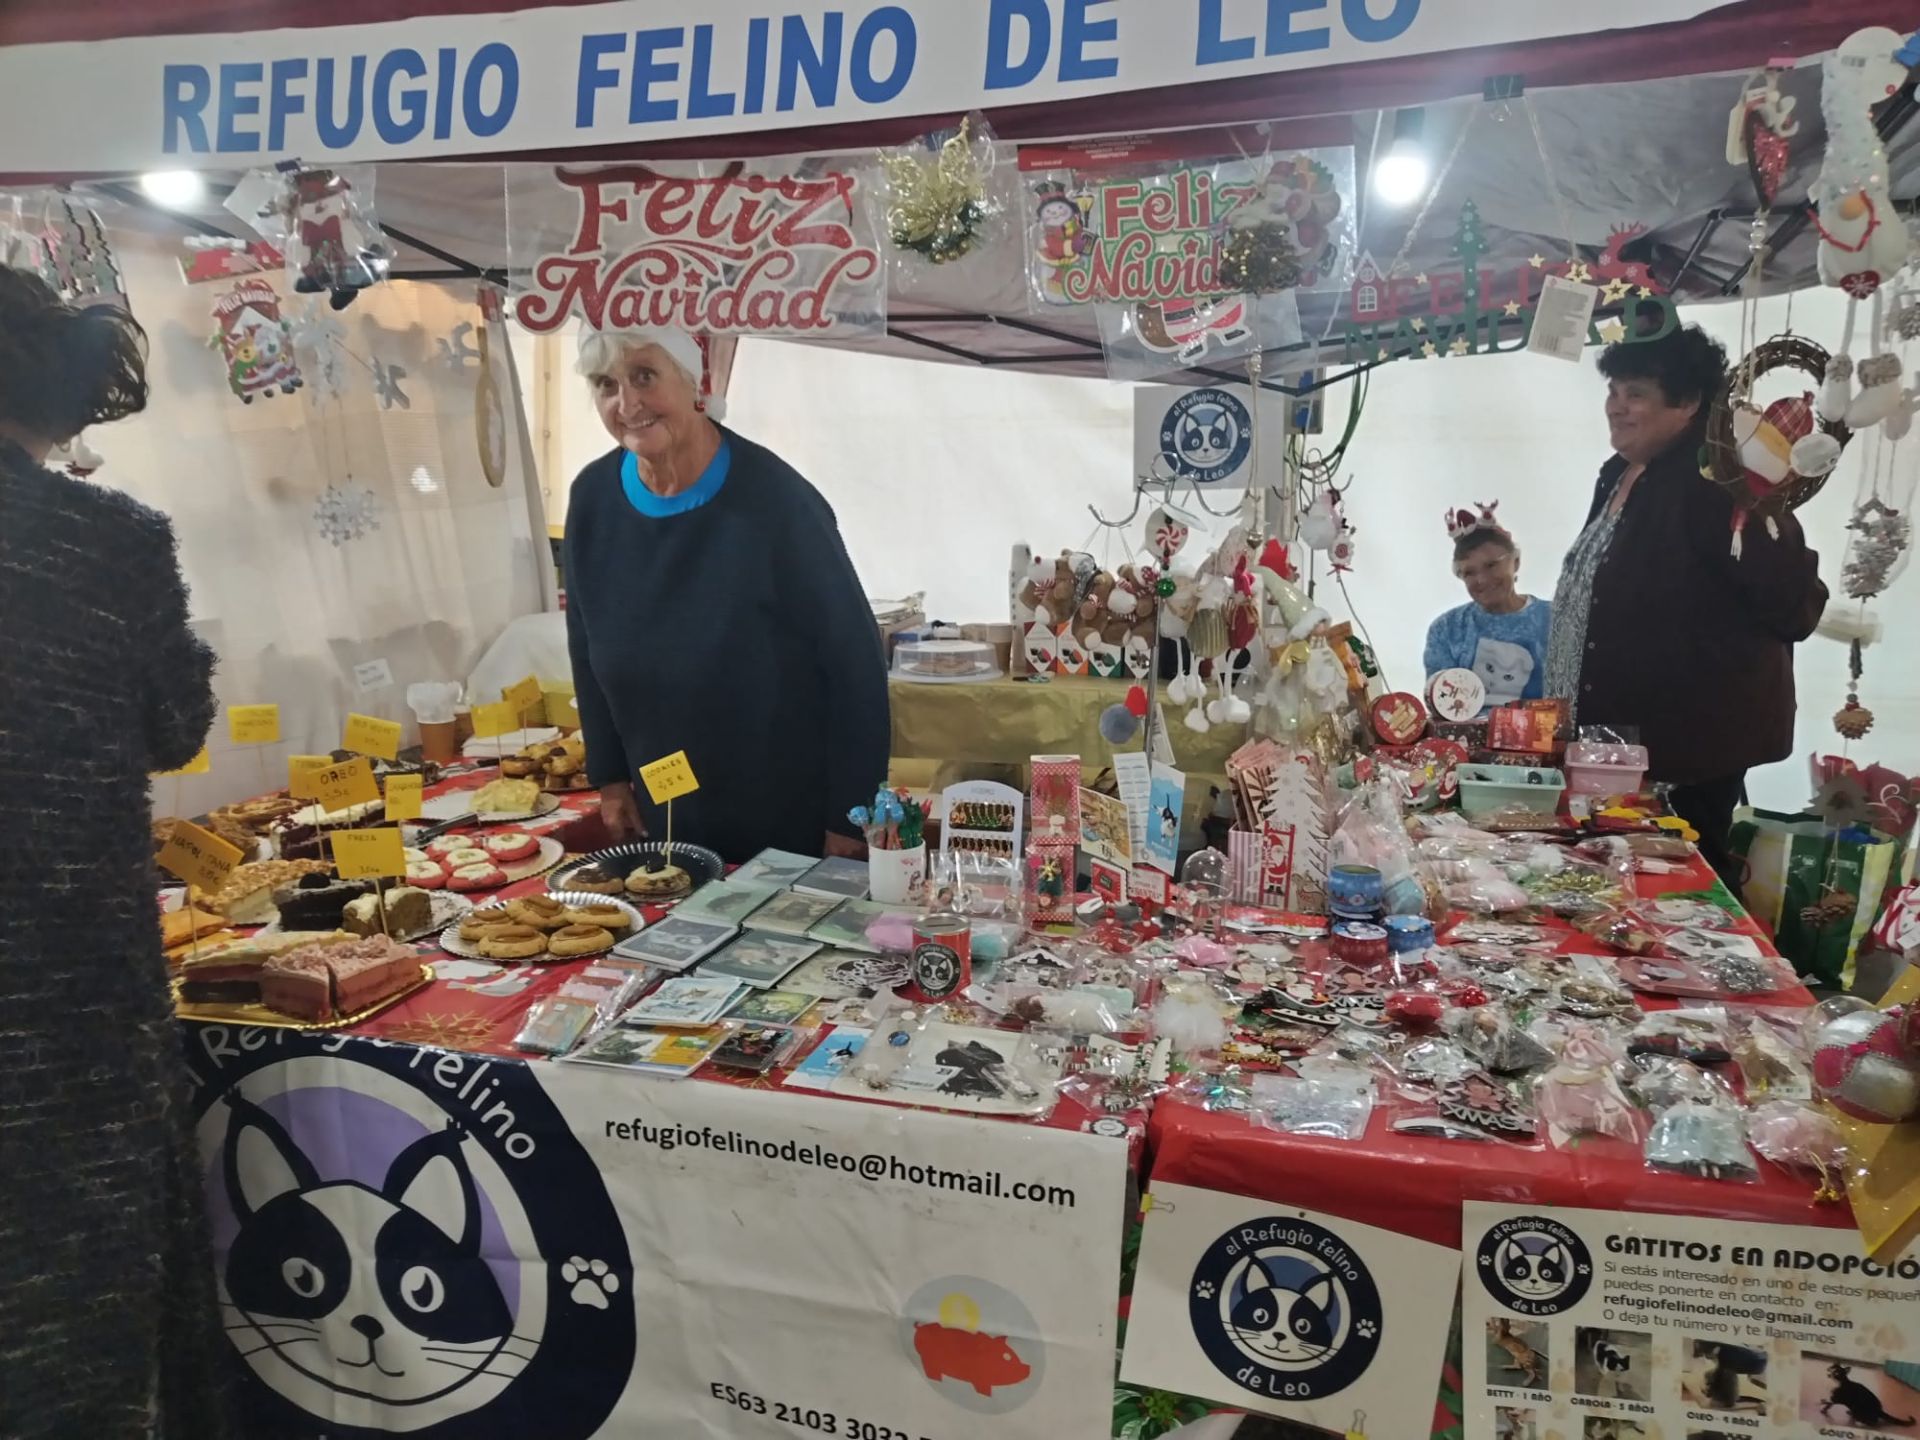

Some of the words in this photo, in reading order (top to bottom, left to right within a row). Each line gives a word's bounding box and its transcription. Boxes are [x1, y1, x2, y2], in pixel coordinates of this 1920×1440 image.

[163, 42, 519, 153] REFUGIO
[575, 6, 917, 129] FELINO
[983, 0, 1119, 91] DE
[555, 161, 855, 256] Feliz
[1066, 230, 1250, 301] Navid
[516, 249, 877, 332] Navidad
[1340, 296, 1678, 366] NAVIDD
[1173, 404, 1182, 417] el
[1180, 392, 1215, 408] Refugio
[1216, 393, 1238, 413] felino
[1203, 468, 1225, 480] Leo
[320, 765, 358, 785] OREO
[1441, 1100, 1522, 1131] XMAS
[604, 1117, 1076, 1207] refugiofelinodeleo@hotmail.com
[1492, 1228, 1503, 1240] el
[1501, 1219, 1545, 1233] Refugio
[1547, 1223, 1575, 1245] felino
[1225, 1235, 1241, 1255] el
[1240, 1222, 1314, 1246] Refugio
[1316, 1237, 1359, 1281] felino
[1604, 1234, 1722, 1263] GATITOS
[1731, 1246, 1764, 1267] EN
[1773, 1249, 1920, 1280] ADOPCIÓ
[1604, 1260, 1617, 1273] Si
[1620, 1264, 1658, 1277] estás
[1662, 1268, 1738, 1286] interesado
[1742, 1276, 1761, 1287] en
[1766, 1279, 1793, 1290] uno
[1798, 1280, 1817, 1293] de
[1821, 1283, 1863, 1297] estos
[1866, 1287, 1920, 1303] pequeñ
[1604, 1278, 1654, 1292] puedes
[1658, 1284, 1714, 1299] ponerte
[1718, 1290, 1737, 1301] en
[1741, 1293, 1805, 1308] contacto
[1814, 1300, 1840, 1312] en:
[1511, 1299, 1529, 1312] de
[1531, 1302, 1558, 1314] Leo
[1604, 1294, 1854, 1329] refugiofelinodeleo@gmail.com
[1603, 1309, 1615, 1321] O
[1618, 1310, 1649, 1326] deja
[1653, 1314, 1668, 1327] tu
[1673, 1316, 1728, 1333] número
[1733, 1325, 1741, 1335] y
[1746, 1325, 1761, 1336] te
[1765, 1325, 1836, 1345] llamamos
[1236, 1365, 1262, 1388] de
[1268, 1374, 1311, 1396] Leo
[1486, 1388, 1514, 1398] BETTY
[710, 1381, 768, 1415] ES63
[773, 1402, 837, 1434] 2103
